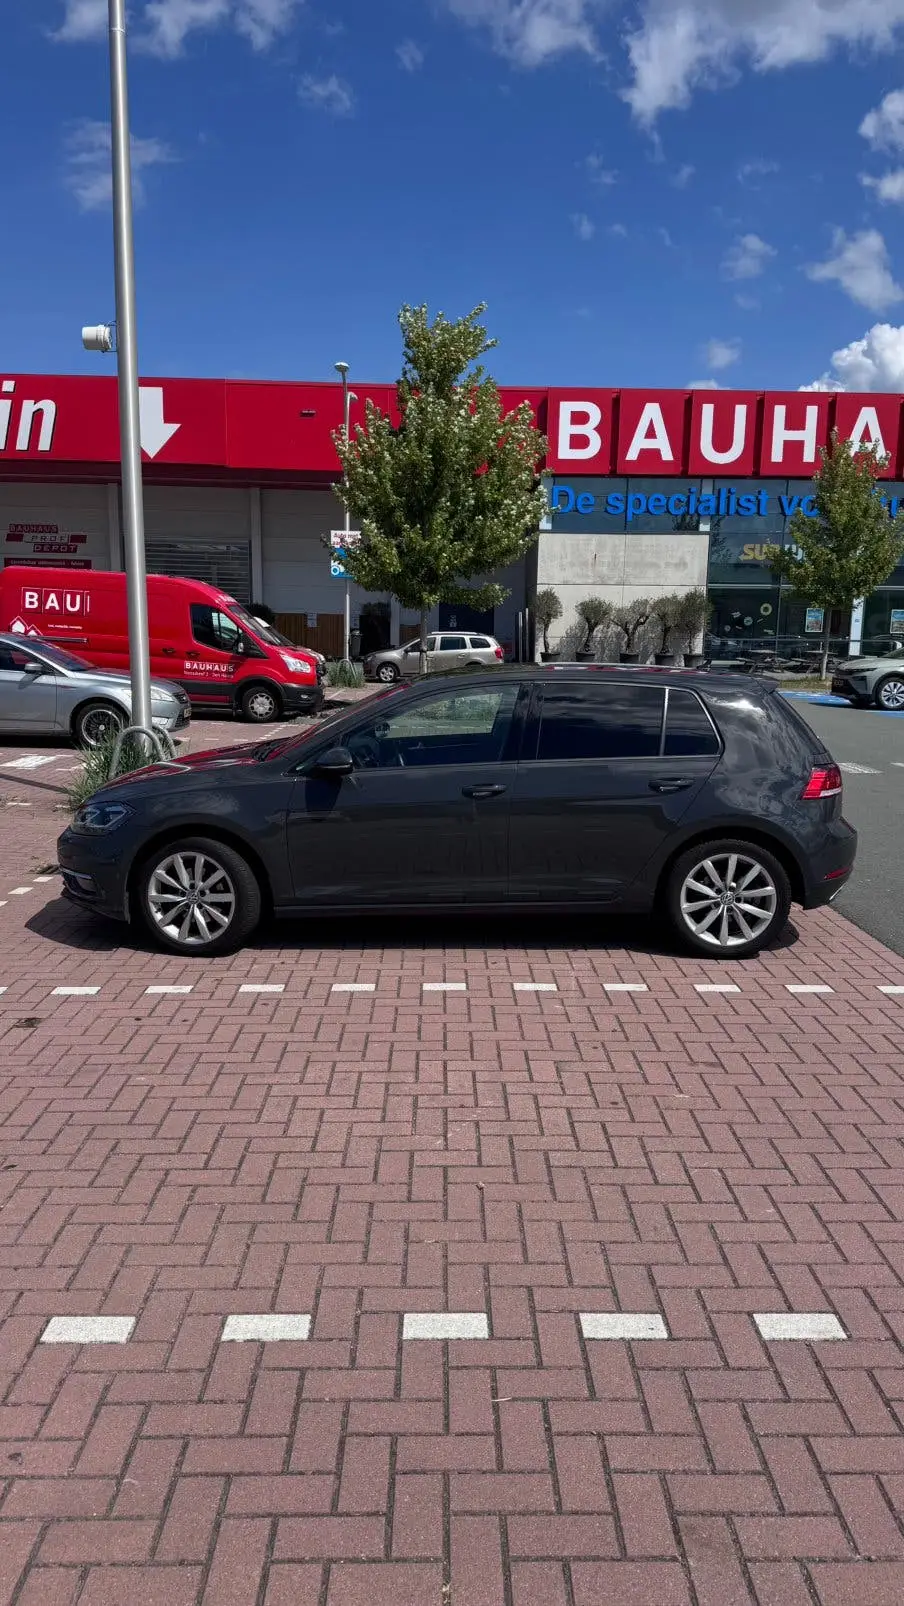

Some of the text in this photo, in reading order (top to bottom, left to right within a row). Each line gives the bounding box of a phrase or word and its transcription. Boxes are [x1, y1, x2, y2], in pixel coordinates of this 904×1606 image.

[557, 401, 888, 464] BAUHA
[551, 485, 594, 515] De
[605, 487, 768, 521] specialist
[10, 524, 58, 534] BAUHAUS
[25, 591, 90, 612] BAU
[185, 662, 234, 672] BAUHAUS
